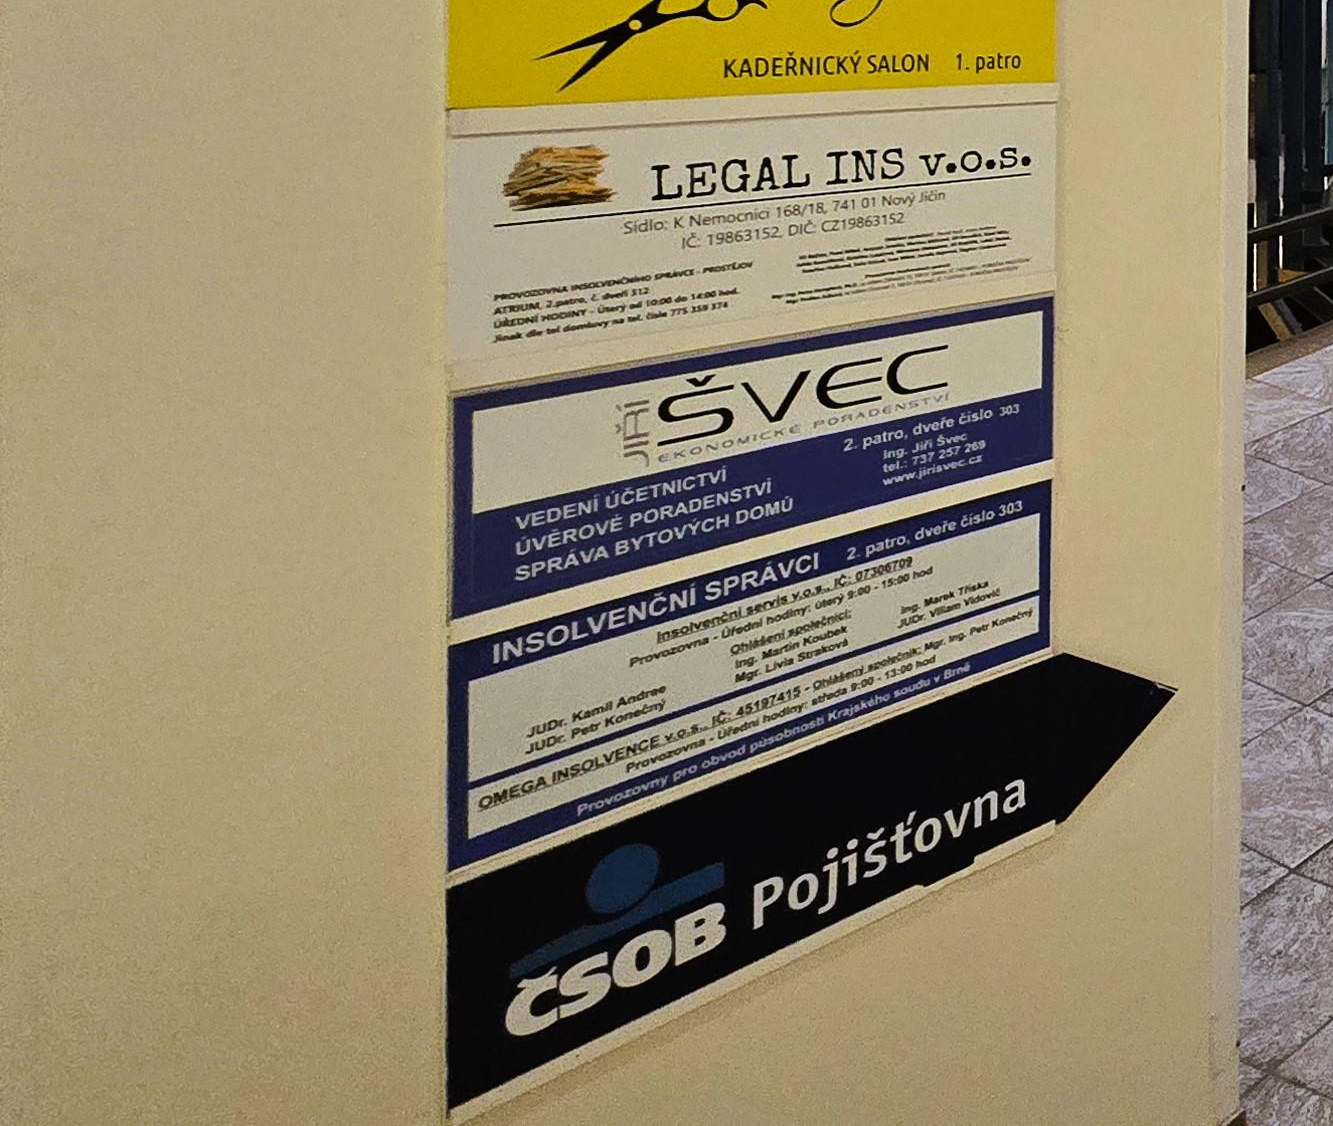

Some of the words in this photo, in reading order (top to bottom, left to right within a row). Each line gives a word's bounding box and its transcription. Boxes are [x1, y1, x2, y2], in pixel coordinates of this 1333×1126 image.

[723, 50, 862, 79] KADEŘNICKÝ
[866, 53, 930, 75] SALON
[956, 53, 970, 72] 1.
[975, 51, 1022, 74] patro
[651, 154, 811, 202] LEGAL
[825, 147, 905, 185] INS
[919, 147, 1032, 176] v.o.s.
[623, 218, 669, 235] Sídlo:
[673, 216, 684, 229] K
[689, 207, 770, 227] Nemocnici
[775, 202, 828, 218] 168/18,
[832, 199, 856, 212] 741
[861, 196, 877, 209] 01
[881, 192, 916, 207] Nový
[706, 225, 784, 246] 19863152,
[821, 212, 906, 233] CZ19863152
[493, 285, 568, 302] PROVOZOVNA
[657, 344, 950, 448] ŠVEC
[812, 391, 952, 430] PORADENSTVÍ
[615, 399, 650, 468] JIŘÍ
[843, 438, 858, 452] 2.
[862, 428, 909, 451] patro,
[912, 417, 955, 436] dveře
[958, 407, 994, 425] číslo
[999, 403, 1021, 417] 303
[883, 446, 909, 461] Ing.
[911, 438, 934, 454] Jiří
[936, 431, 969, 447] Švec
[882, 460, 909, 474] tel.:
[911, 453, 934, 467] 737
[938, 445, 961, 459] 257
[882, 454, 984, 487] www.jirisvec.cz
[514, 517, 623, 557] ÚVĚROVÉ
[628, 477, 773, 528] PORADENSTVÍ
[515, 496, 599, 530] VEDENÍ
[604, 464, 728, 510] ÚČETNICTVÍ
[514, 546, 609, 582] SPRÁVA
[614, 514, 730, 557] BYTOVÝCH
[491, 582, 697, 665] INSOLVENČNÍ
[704, 552, 820, 602] SPRÁVCI
[846, 547, 861, 561] 2.
[865, 534, 911, 558] patro,
[914, 519, 957, 542] dveře
[959, 510, 996, 529] číslo
[997, 500, 1024, 516] 303
[923, 590, 956, 608] Marek
[628, 636, 710, 668] Provozovna
[720, 617, 763, 640] Úřední
[814, 591, 845, 611] úterý
[846, 585, 872, 601] 9:00
[880, 573, 910, 590] 15:00
[912, 565, 934, 580] hod
[656, 607, 743, 645] Insolvenční
[745, 593, 789, 616] servis
[896, 614, 928, 630] JUDr.
[734, 654, 759, 670] Ing.
[761, 637, 801, 661] Martin
[802, 625, 850, 647] Koubek
[734, 669, 762, 685] Mgr.
[797, 637, 850, 662] Straková
[478, 775, 548, 811] OMEGA
[551, 734, 661, 784] INSOLVENCE
[735, 685, 802, 718] 45197415
[924, 638, 947, 652] Mgr.
[969, 623, 990, 637] Petr
[991, 607, 1034, 629] Konečný
[524, 734, 567, 756] JUDr.
[570, 721, 602, 739] Petr
[604, 698, 667, 728] Konečný
[525, 717, 568, 739] JUDr.
[570, 700, 614, 723] Kamil
[625, 737, 706, 773] Provozovna
[810, 686, 848, 707] středa
[850, 675, 875, 693] 9:00
[884, 663, 914, 680] 13:00
[915, 655, 937, 670] hod
[576, 774, 669, 817] Provozovny
[672, 764, 699, 782] pro
[700, 744, 748, 770] obvod
[749, 714, 825, 755] působnosti
[827, 693, 891, 722] Krajského
[893, 678, 931, 699] soudu
[933, 675, 941, 683] v
[943, 661, 972, 681] Brně
[504, 900, 728, 1039] ČSOB
[751, 776, 1028, 932] Pojišťovna
